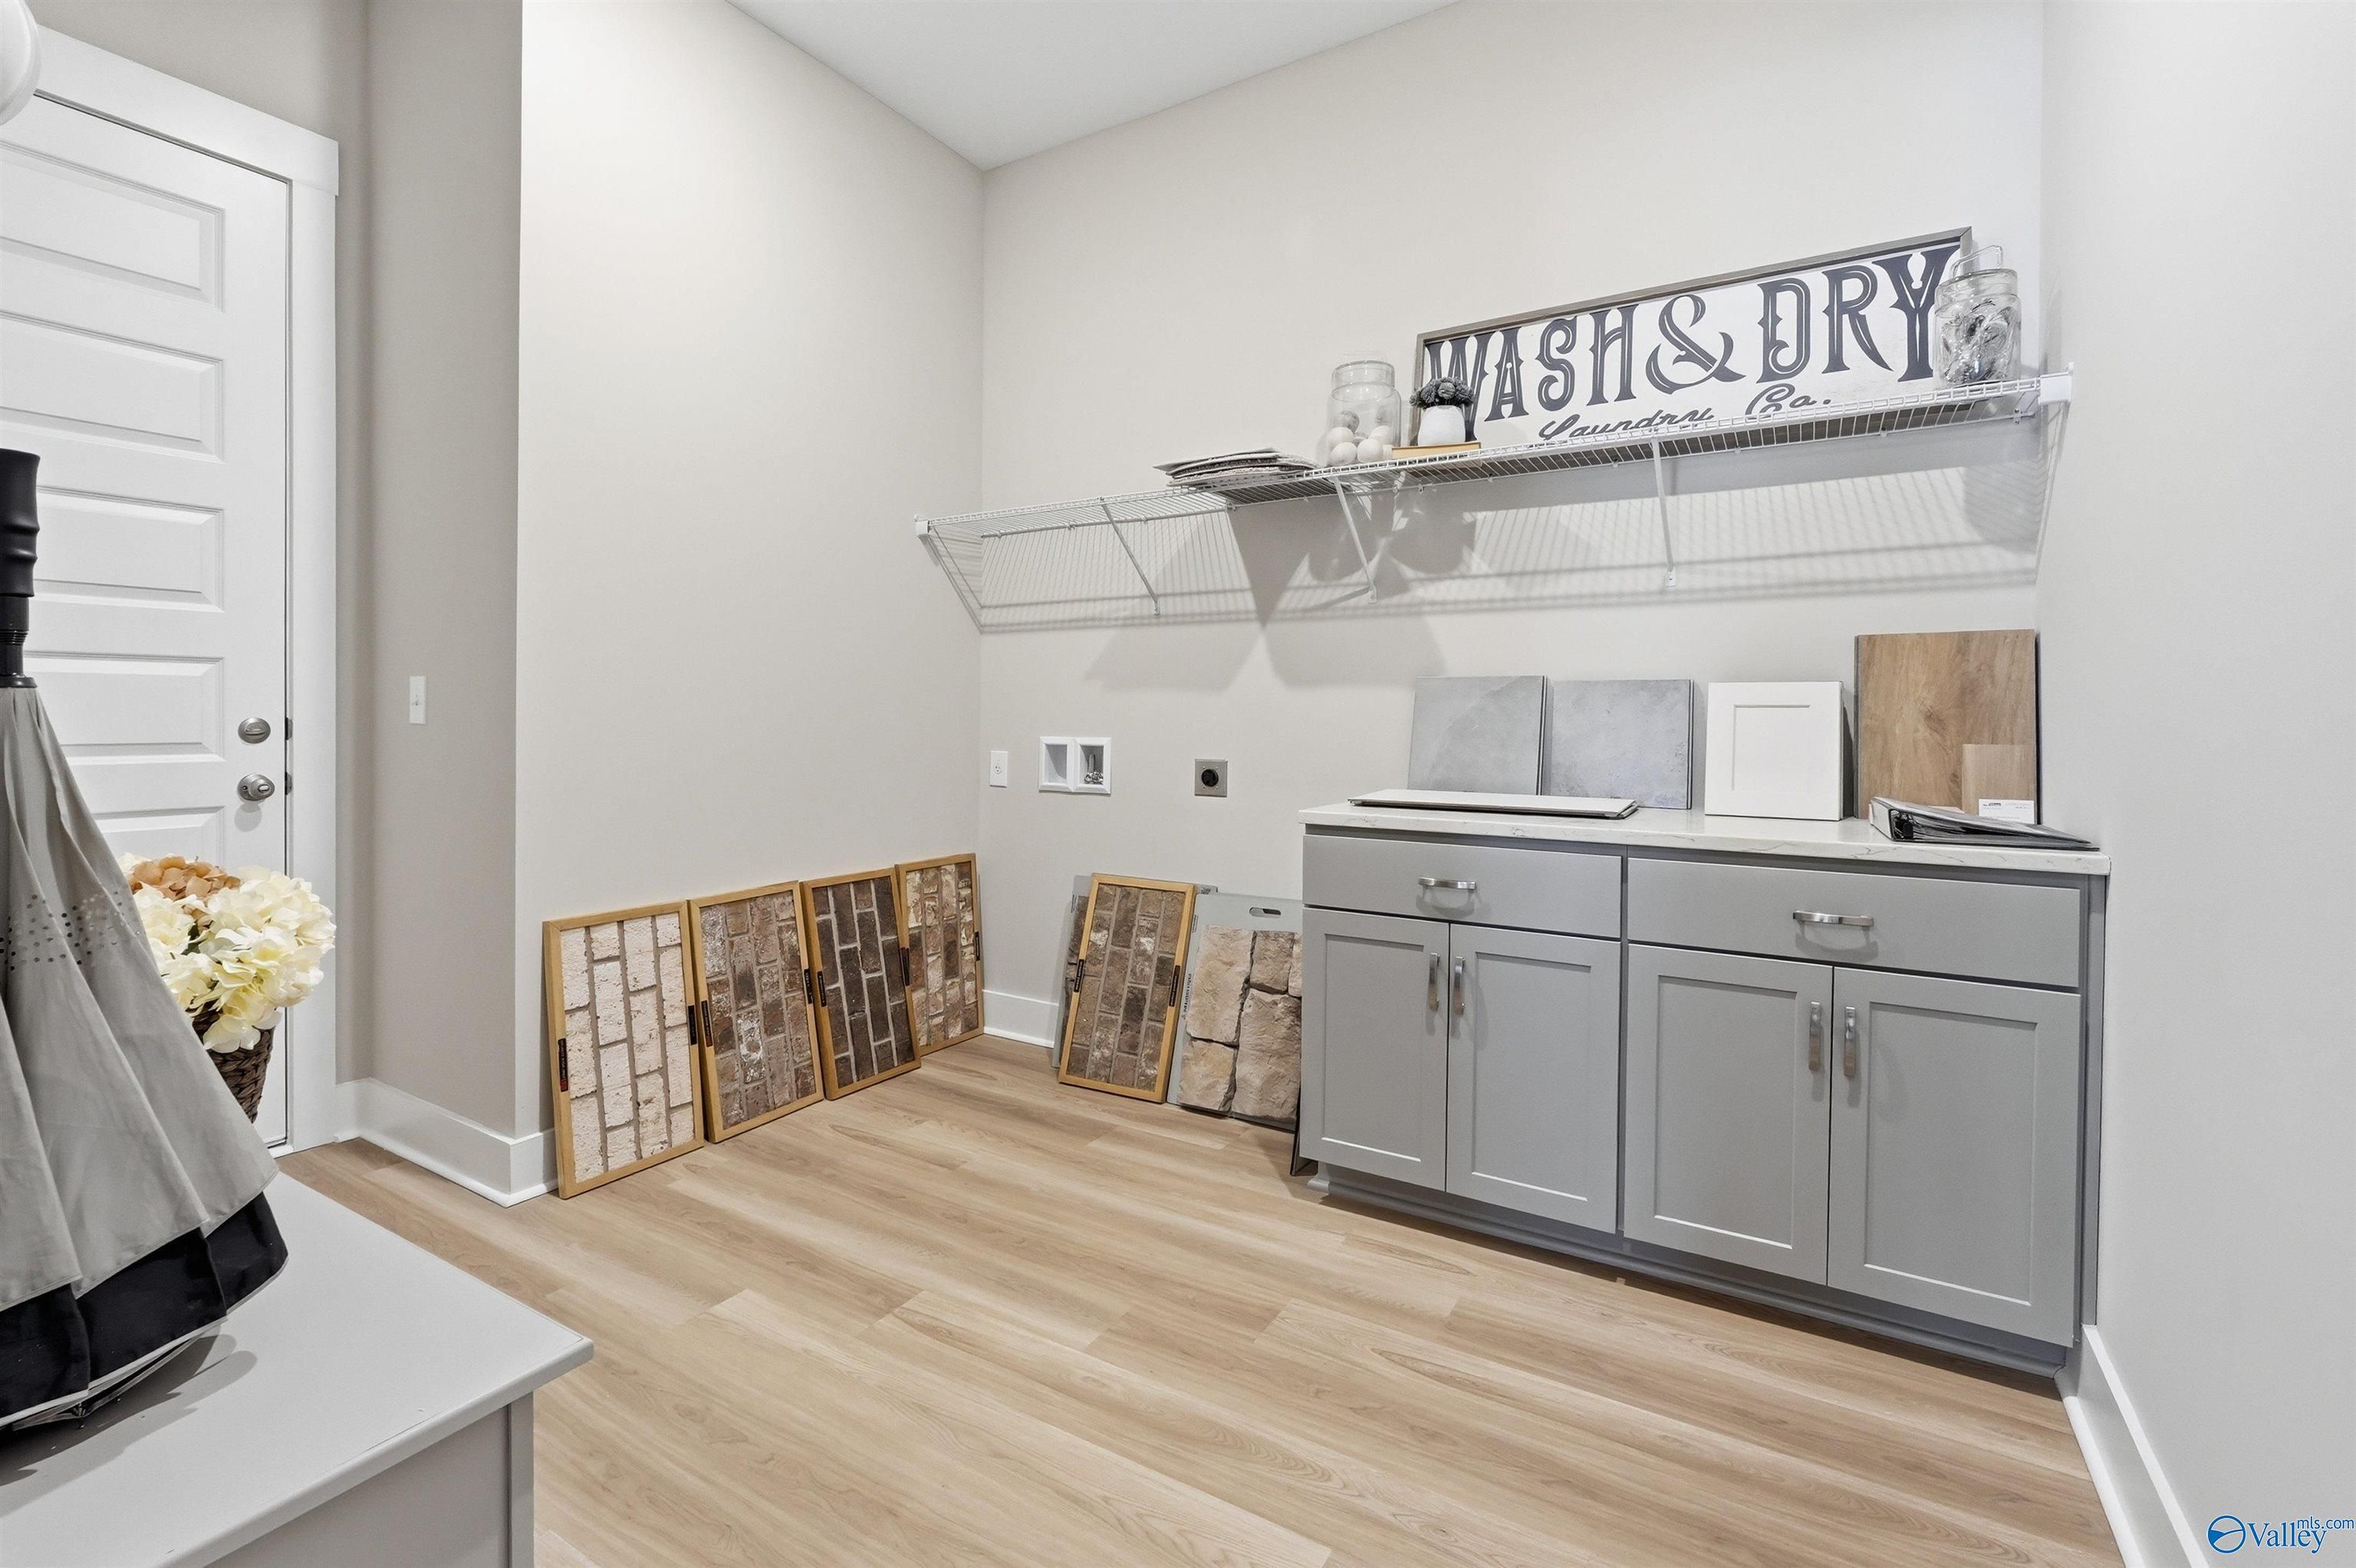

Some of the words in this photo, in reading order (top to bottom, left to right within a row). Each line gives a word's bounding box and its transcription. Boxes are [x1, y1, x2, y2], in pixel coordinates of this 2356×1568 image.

[1424, 306, 1637, 441] WASH
[1646, 294, 1746, 396] &
[1756, 245, 1961, 383] DRY
